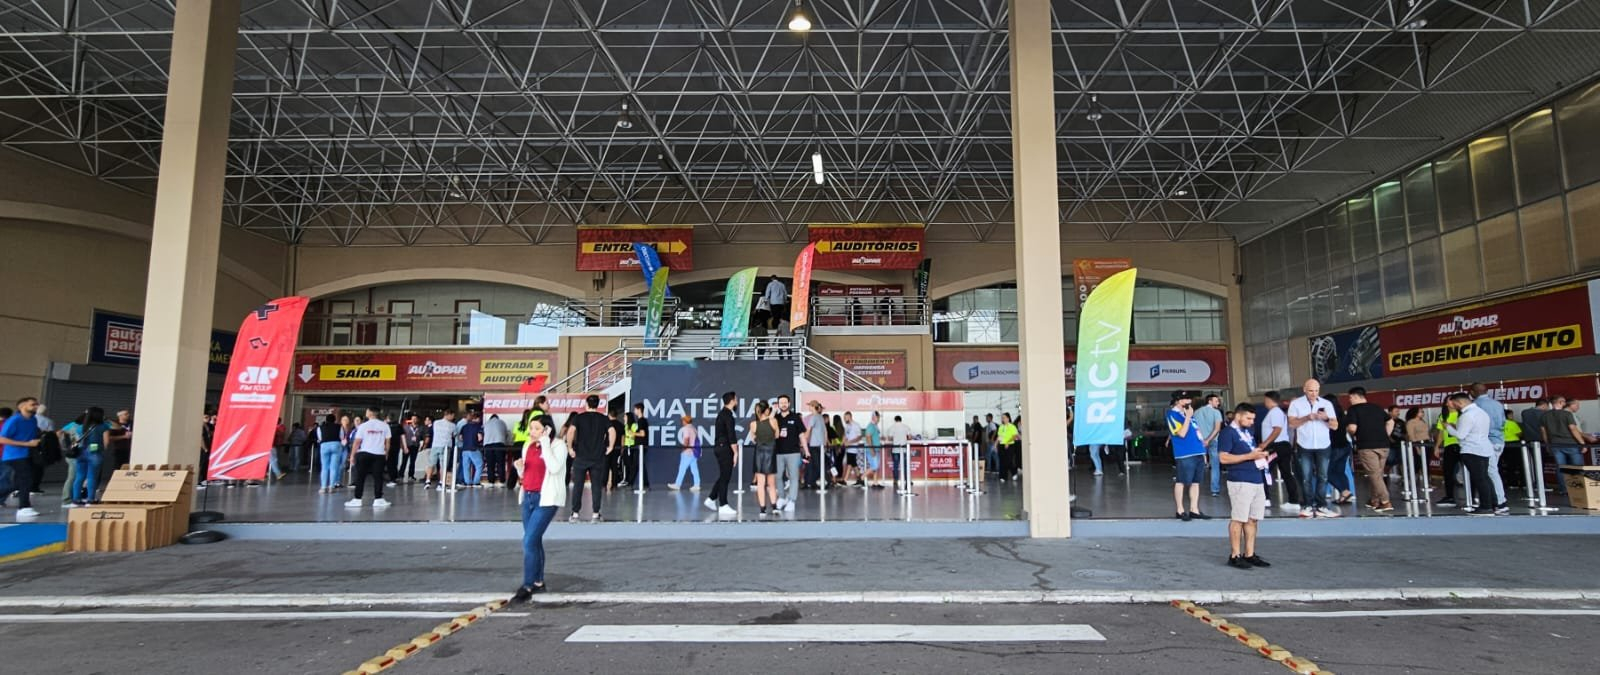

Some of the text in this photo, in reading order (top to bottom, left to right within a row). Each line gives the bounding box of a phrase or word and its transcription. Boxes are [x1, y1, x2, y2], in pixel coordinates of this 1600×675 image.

[593, 243, 658, 252] ENTRA
[833, 241, 918, 251] AUDITÓRIOS
[1391, 329, 1576, 368] CREDENCIAMENTO
[336, 367, 380, 378] SAÍDA
[484, 374, 530, 383] AUDITÓR
